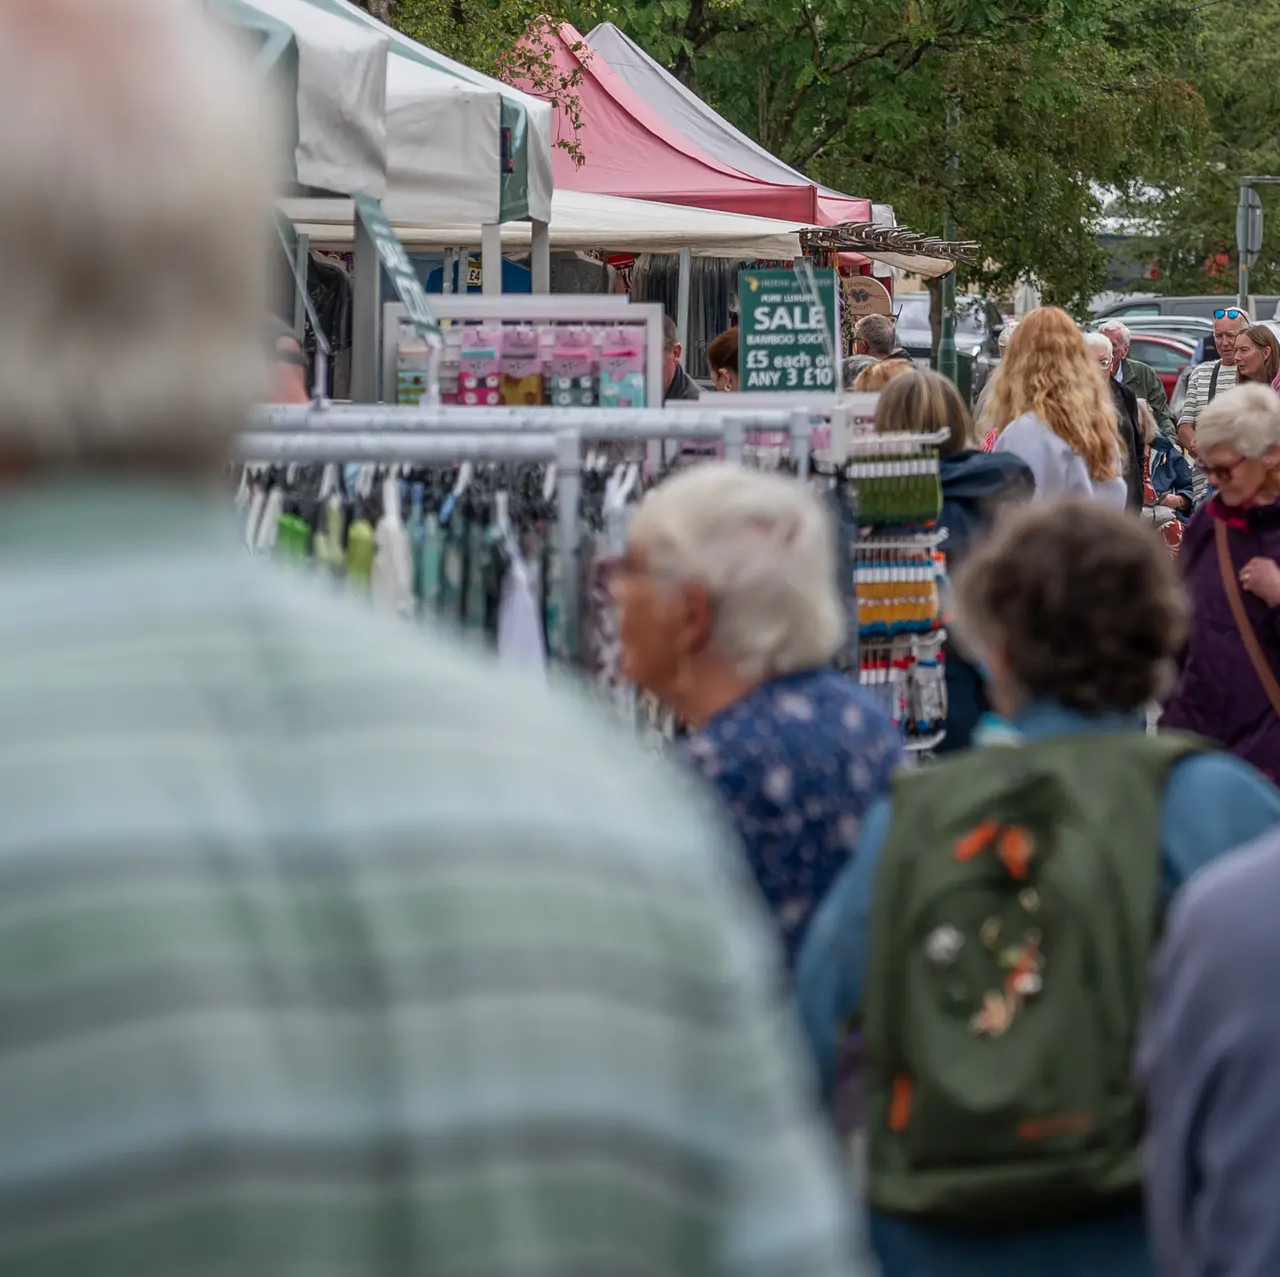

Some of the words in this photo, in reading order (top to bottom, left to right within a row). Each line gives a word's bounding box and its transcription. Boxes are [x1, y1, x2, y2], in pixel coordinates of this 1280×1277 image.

[469, 270, 481, 281] £4
[753, 305, 825, 330] SALE
[746, 333, 796, 345] BAMBOO
[797, 333, 830, 344] SOCK
[746, 349, 769, 369] £5
[773, 351, 812, 369] each
[747, 371, 781, 386] ANY
[786, 367, 798, 386] 3
[803, 367, 833, 386] £10
